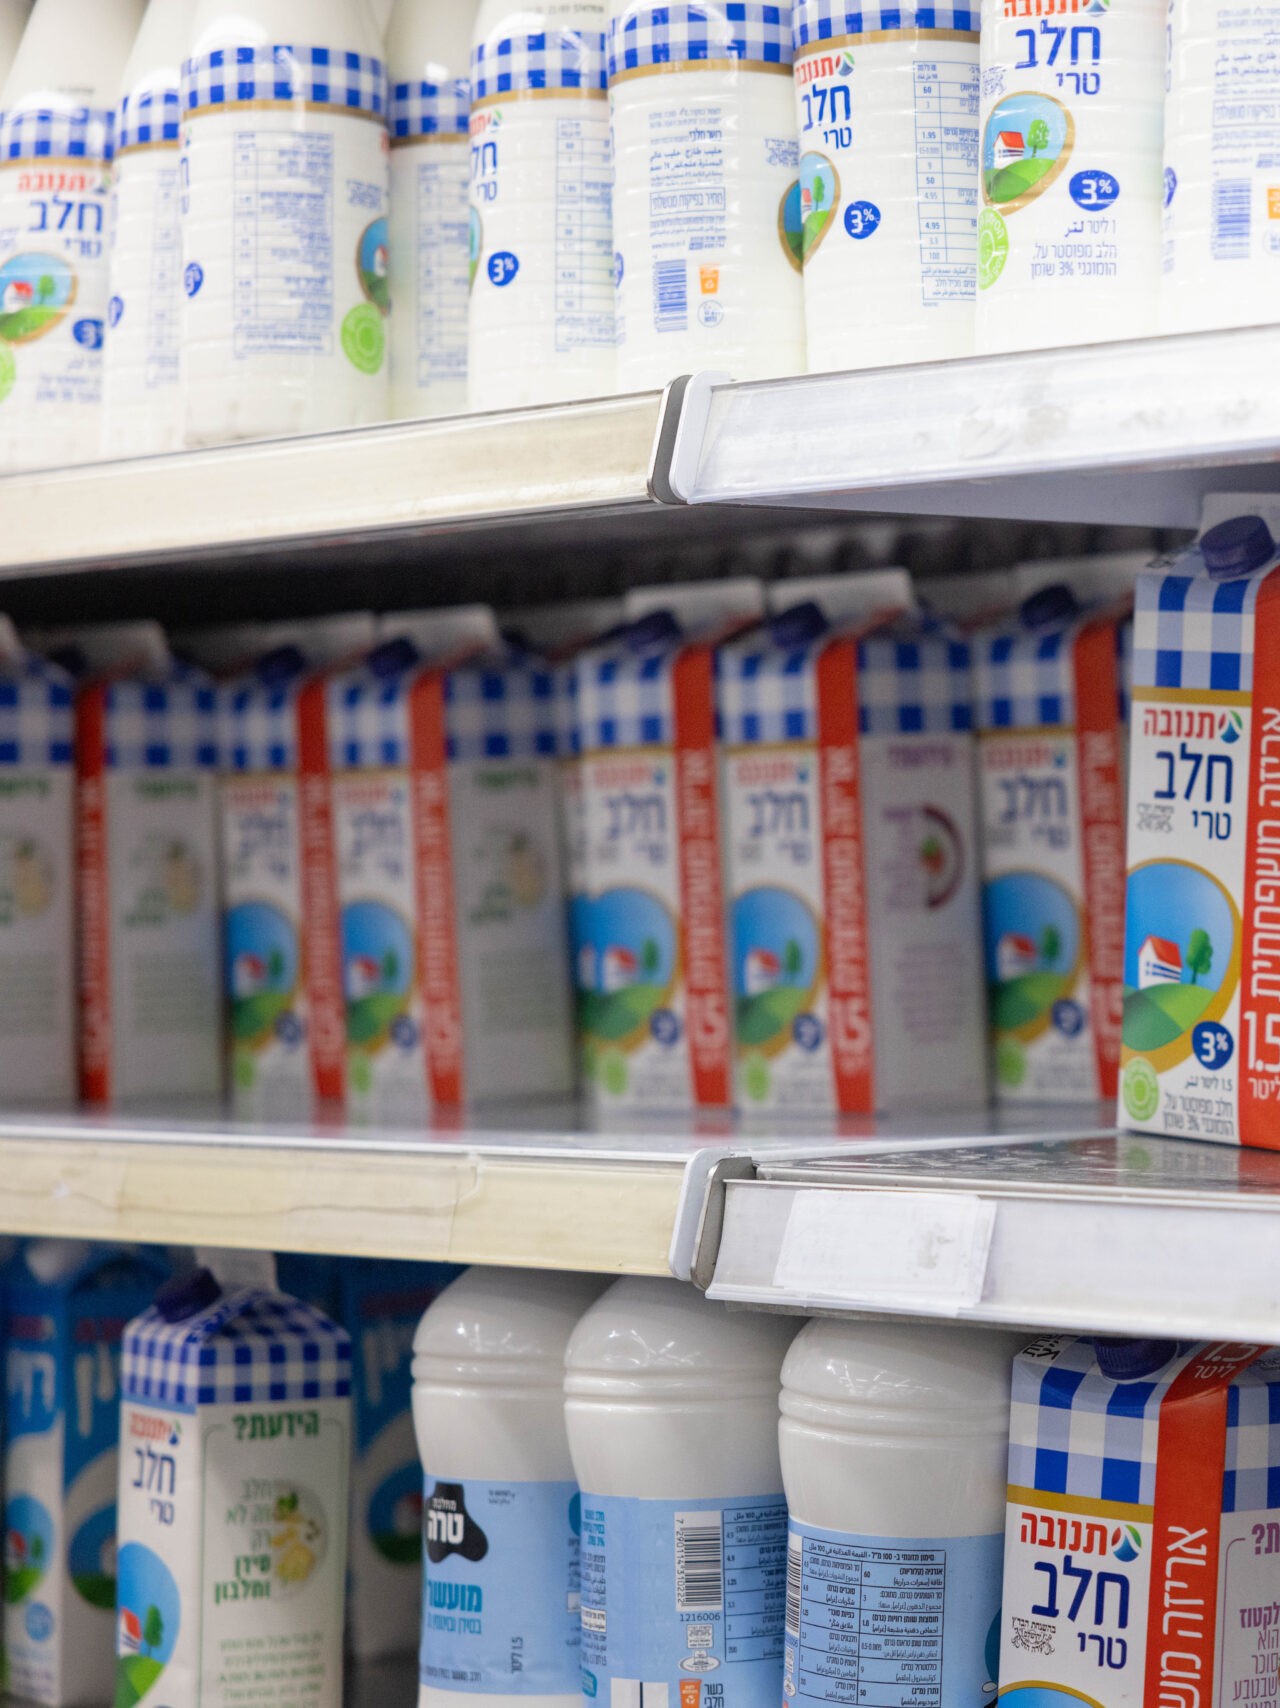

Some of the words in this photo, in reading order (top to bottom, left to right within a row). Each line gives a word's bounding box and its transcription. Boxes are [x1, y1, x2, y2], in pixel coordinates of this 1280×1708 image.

[1015, 20, 1100, 69] חלב
[1056, 72, 1100, 95] טרי
[802, 84, 851, 132] חלב
[823, 127, 852, 150] טרי
[1081, 178, 1112, 205] 3%
[29, 194, 103, 232] חלב
[850, 208, 874, 234] 3%
[1088, 218, 1110, 234] ליטר
[1051, 244, 1094, 259] מפוסטר
[1096, 242, 1117, 259] חלב
[1030, 260, 1056, 280] שומן
[1060, 261, 1074, 276] 3%
[1143, 708, 1214, 739] תנובה
[1154, 743, 1233, 804] חלב
[1192, 810, 1231, 840] טרי
[1201, 1031, 1229, 1062] 3%
[1194, 1363, 1238, 1380] ליטר
[233, 1410, 319, 1442] הידעת?
[132, 1445, 176, 1495] חלב
[148, 1499, 175, 1526] טרי
[427, 1510, 464, 1545] טרה
[1020, 1512, 1108, 1556] תנובה
[234, 1554, 271, 1579] סידן
[214, 1580, 271, 1604] וחלבון
[1031, 1555, 1130, 1630] חלב
[1162, 1525, 1208, 1639] אריזה
[427, 1579, 483, 1613] מועשר
[680, 1612, 721, 1622] 1216006
[1239, 1601, 1280, 1630] לקטוז
[1077, 1632, 1127, 1670] טרי
[1257, 1628, 1279, 1651] הוא
[1251, 1652, 1279, 1676] סוכר
[704, 1683, 723, 1695] כשר
[1232, 1675, 1278, 1701] שבטבע
[704, 1696, 724, 1708] חלבי
